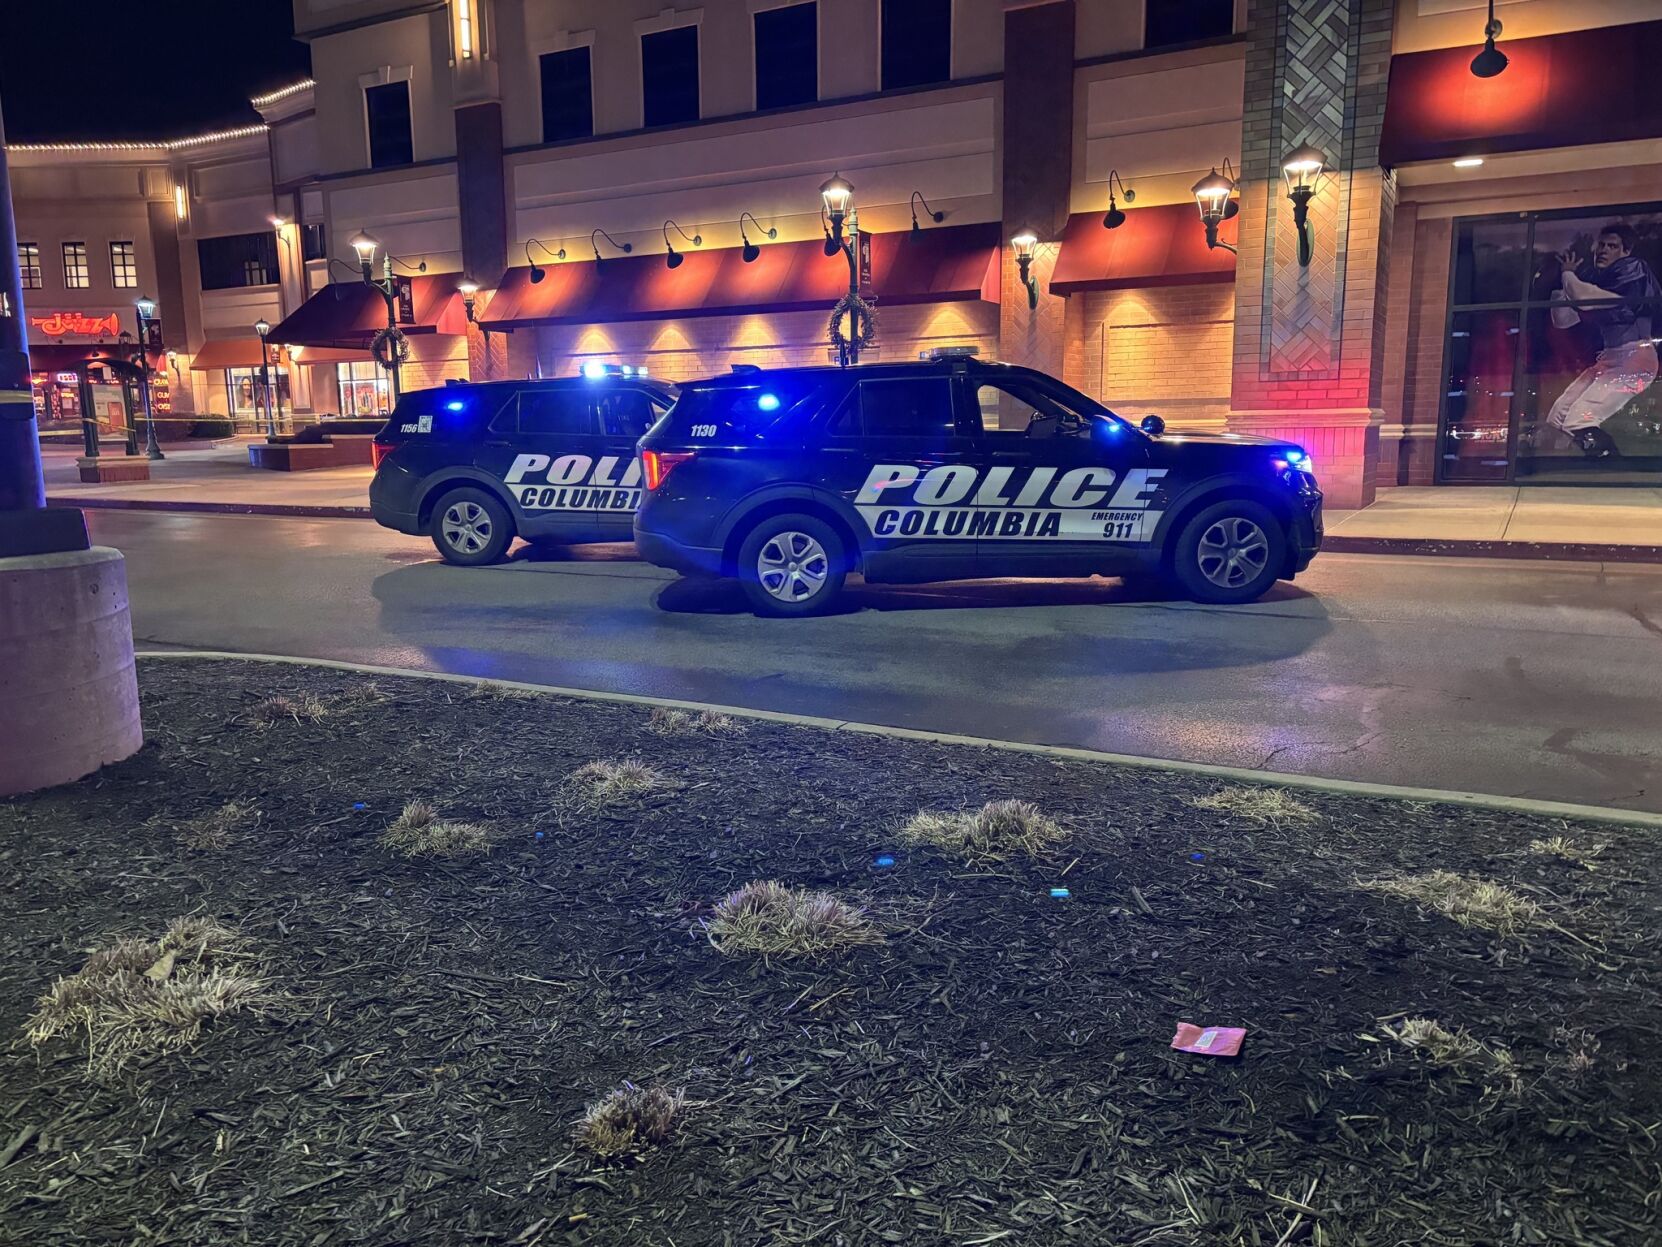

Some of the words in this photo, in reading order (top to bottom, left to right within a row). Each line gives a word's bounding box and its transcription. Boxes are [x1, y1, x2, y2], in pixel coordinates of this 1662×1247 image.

[400, 423, 418, 433] 1156
[690, 424, 718, 438] 1130
[503, 453, 642, 487] POLI
[853, 464, 1169, 509] POLICE
[520, 487, 641, 510] COLUMBI
[874, 509, 1063, 537] COLUMBIA
[1091, 511, 1144, 521] EMERGENCY
[1102, 522, 1134, 539] 911
